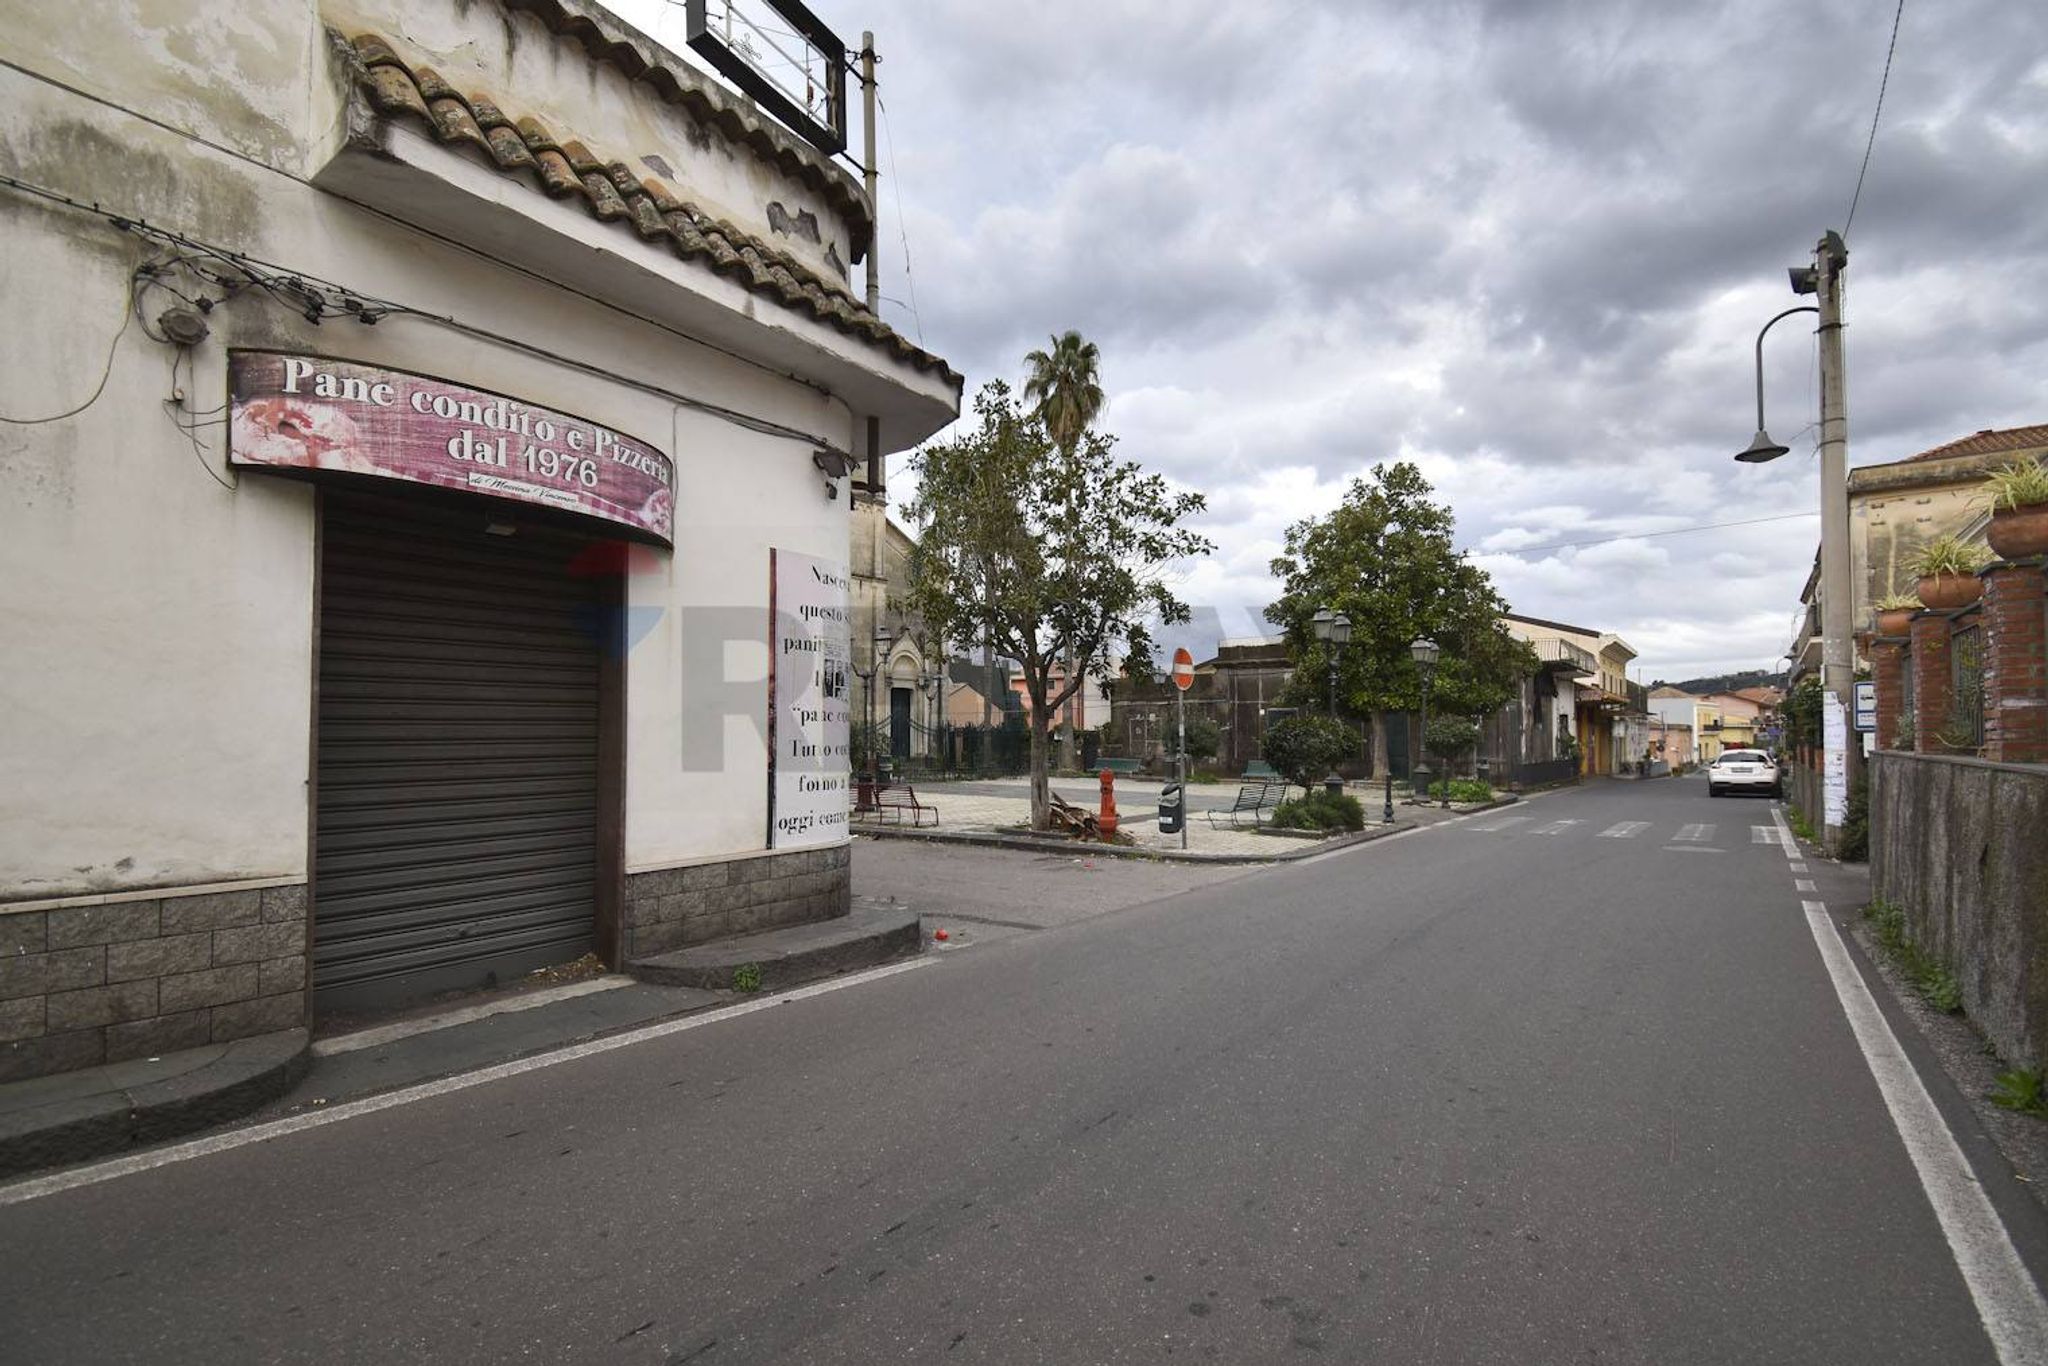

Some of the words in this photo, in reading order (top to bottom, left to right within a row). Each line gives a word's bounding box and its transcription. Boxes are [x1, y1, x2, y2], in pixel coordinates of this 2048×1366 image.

[281, 358, 395, 406] Pane
[410, 391, 556, 442] condito
[566, 429, 584, 451] e
[593, 427, 668, 485] Pizzeria
[447, 428, 508, 468] dal
[523, 444, 598, 488] 1976
[799, 604, 843, 621] questo
[798, 774, 838, 792] forno
[778, 810, 814, 834] oggi
